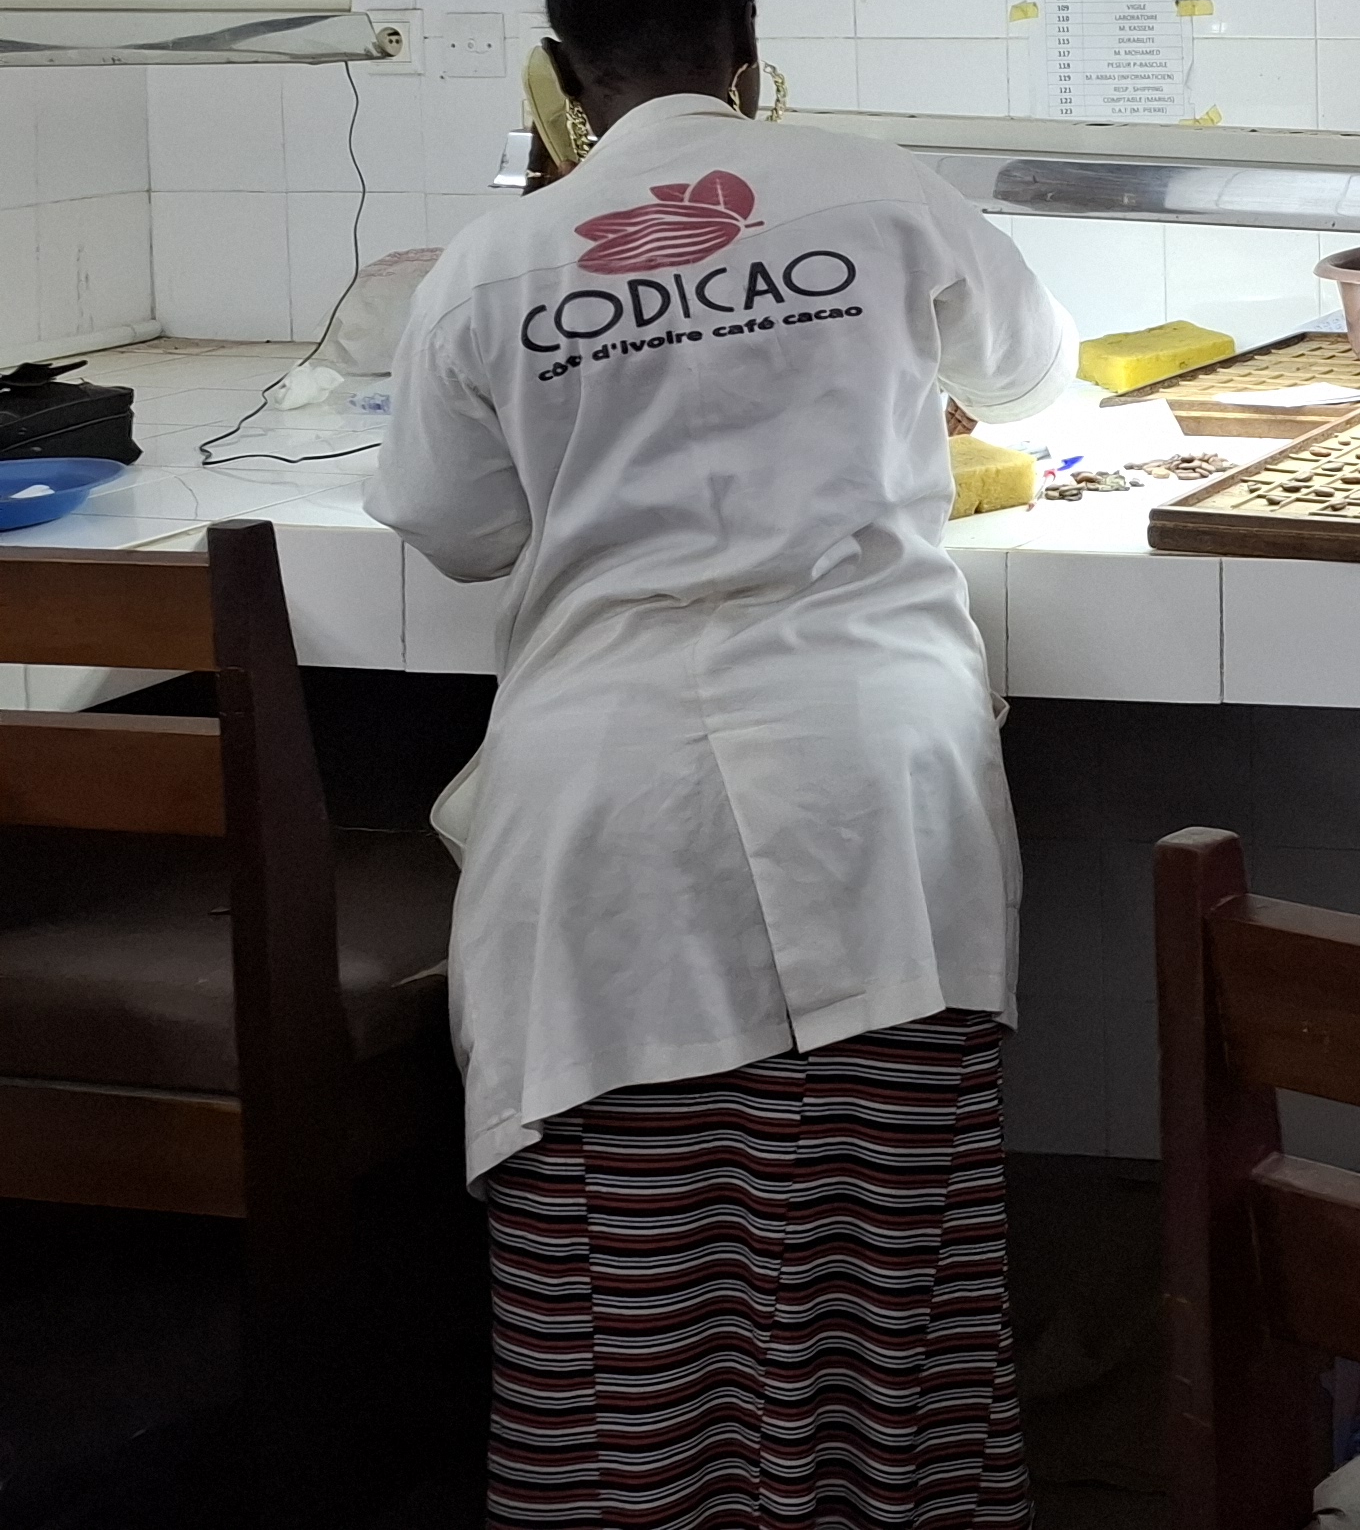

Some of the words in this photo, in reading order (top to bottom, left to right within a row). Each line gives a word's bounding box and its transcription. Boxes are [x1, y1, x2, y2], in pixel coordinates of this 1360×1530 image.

[521, 250, 857, 352] CODICAO
[712, 316, 775, 337] café
[782, 306, 863, 325] cacao
